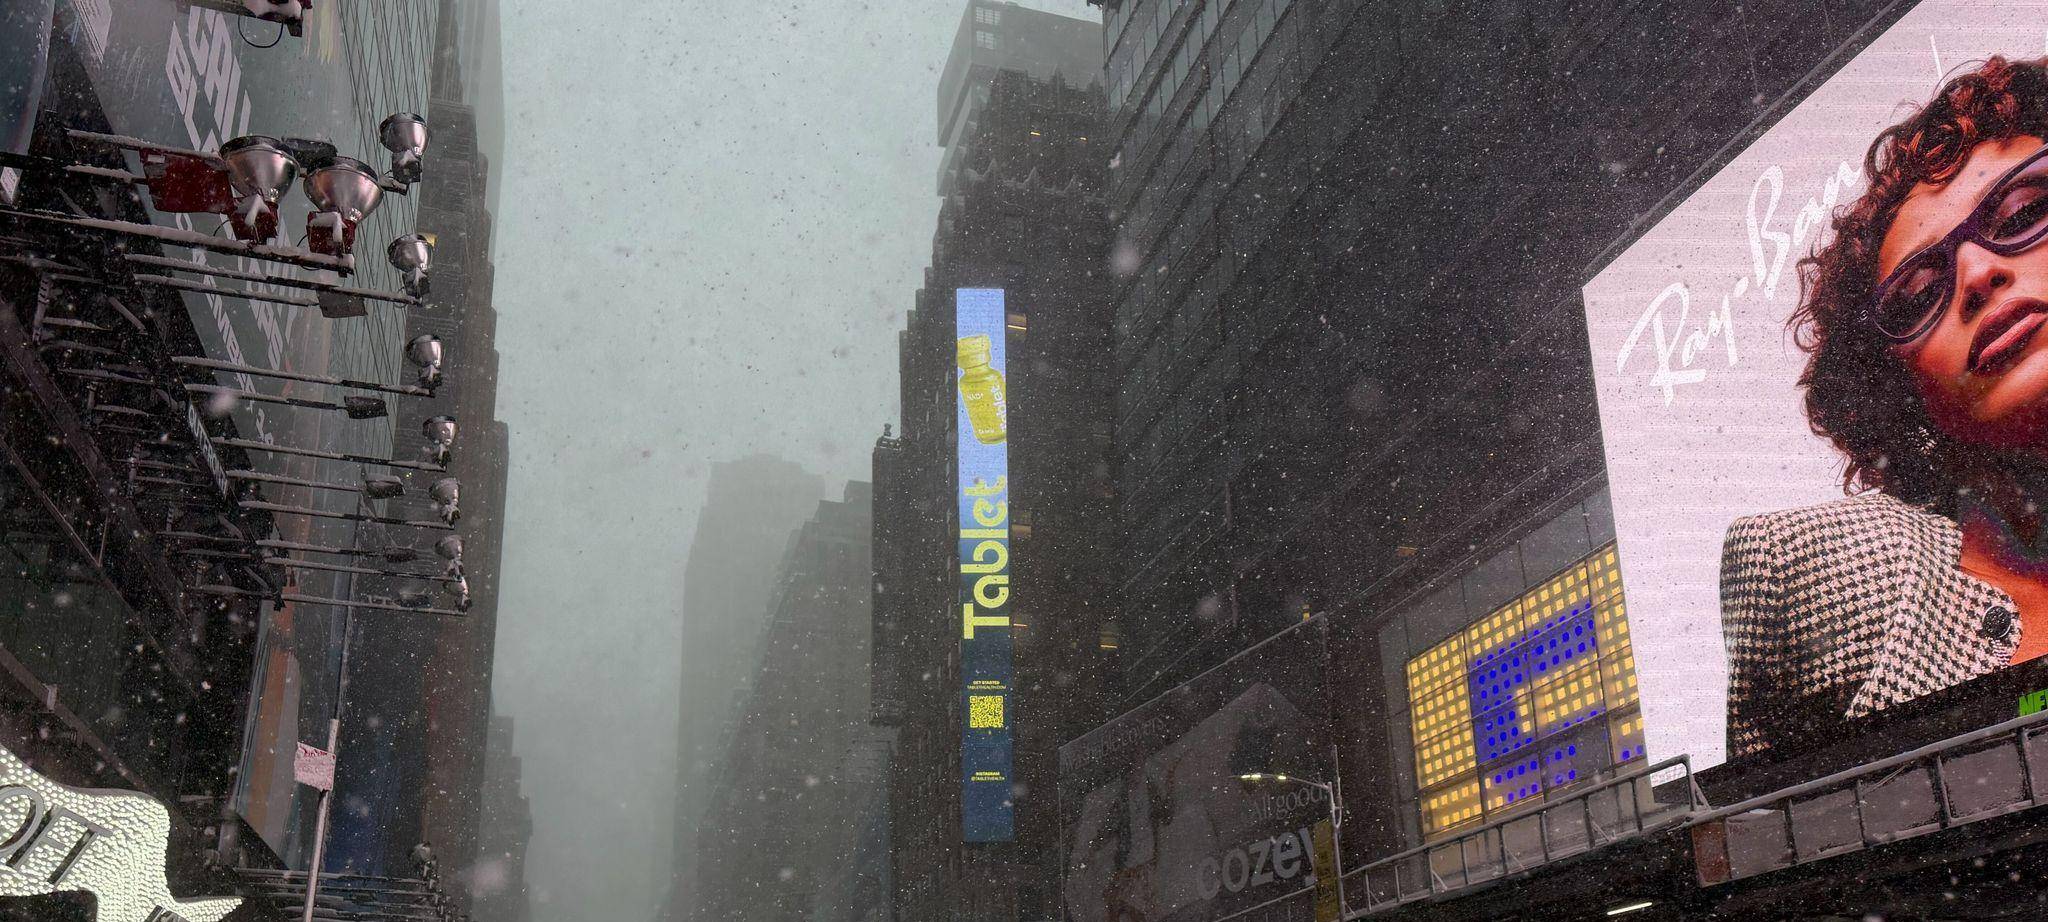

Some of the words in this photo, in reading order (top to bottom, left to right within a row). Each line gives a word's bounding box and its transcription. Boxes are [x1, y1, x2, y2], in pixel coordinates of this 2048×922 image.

[1617, 161, 1863, 408] Ray-Ban
[961, 475, 1010, 640] Tablet
[2018, 689, 2048, 717] NE
